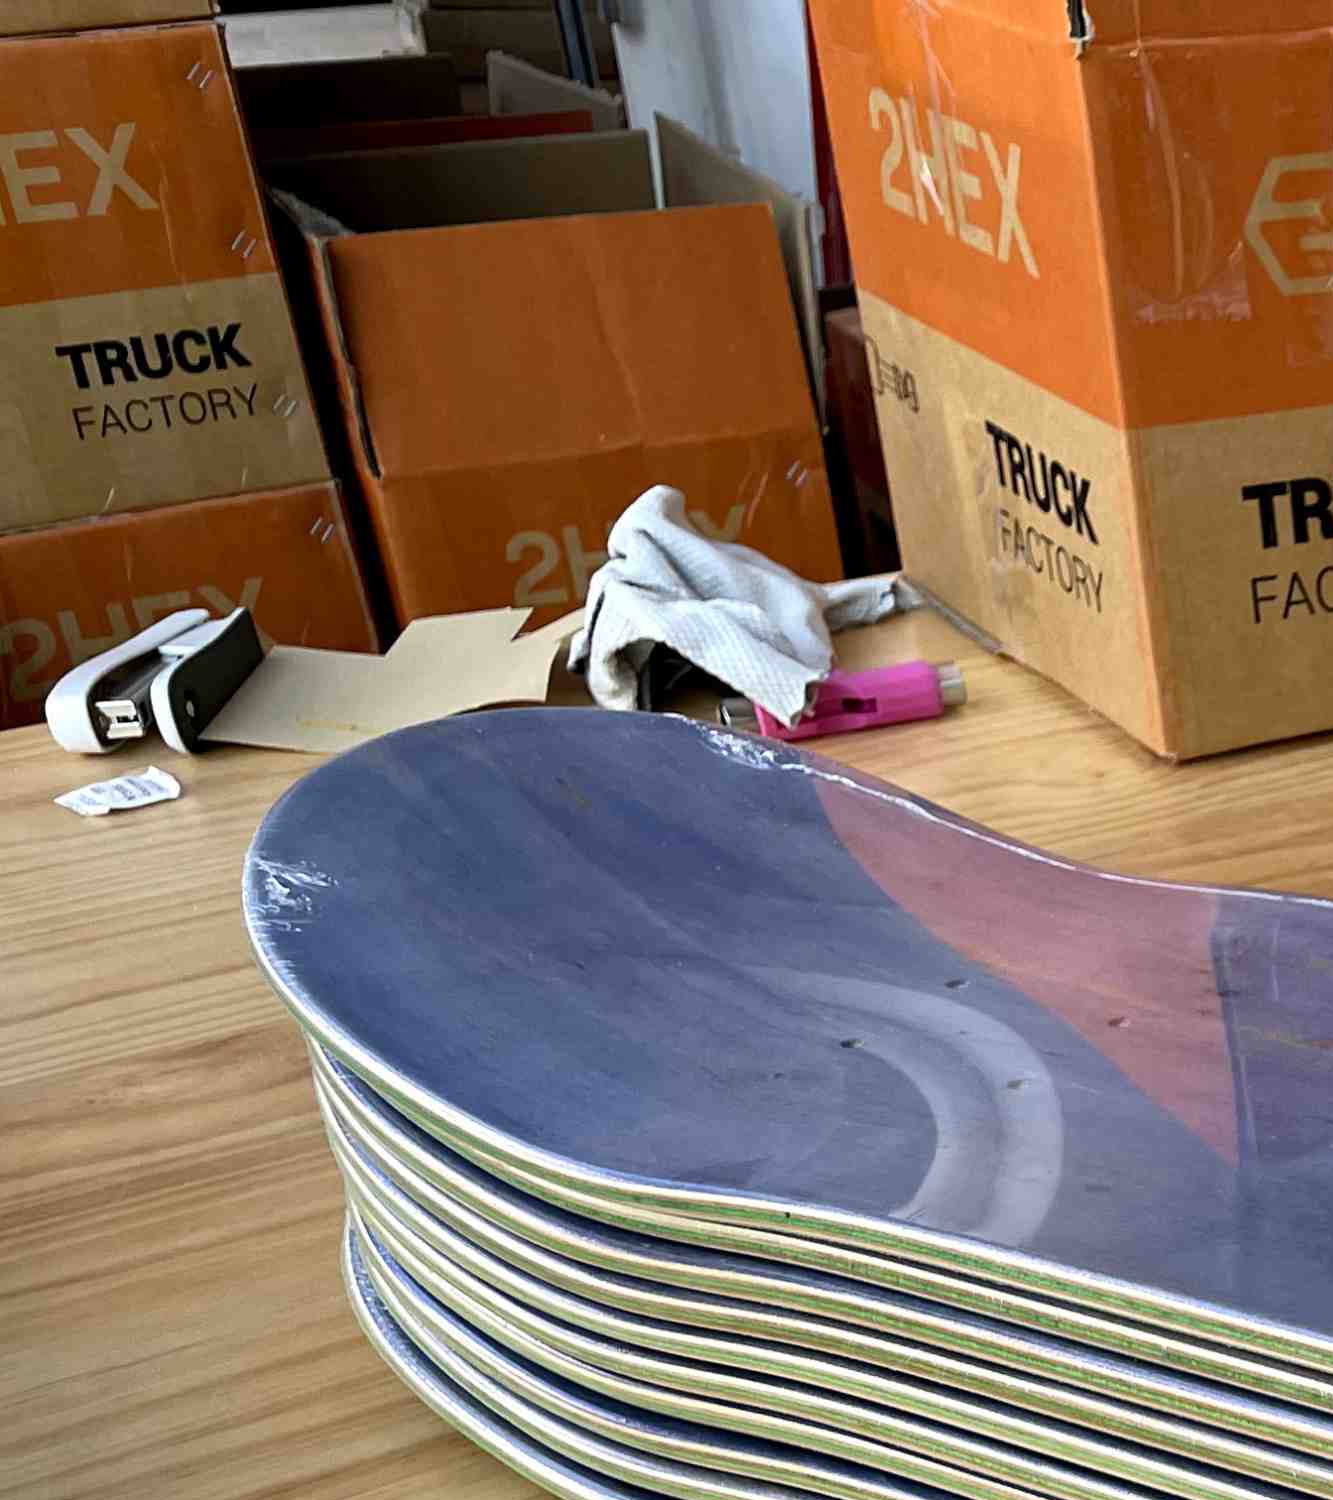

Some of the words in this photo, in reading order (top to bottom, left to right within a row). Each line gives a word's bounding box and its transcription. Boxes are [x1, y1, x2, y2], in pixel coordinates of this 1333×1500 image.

[0, 121, 160, 227] EX
[868, 86, 1041, 280] 2HEX
[55, 322, 253, 390] TRUCK
[71, 383, 258, 441] FACTORY
[985, 419, 1099, 546] TRUCK
[998, 508, 1104, 613] FACTORY
